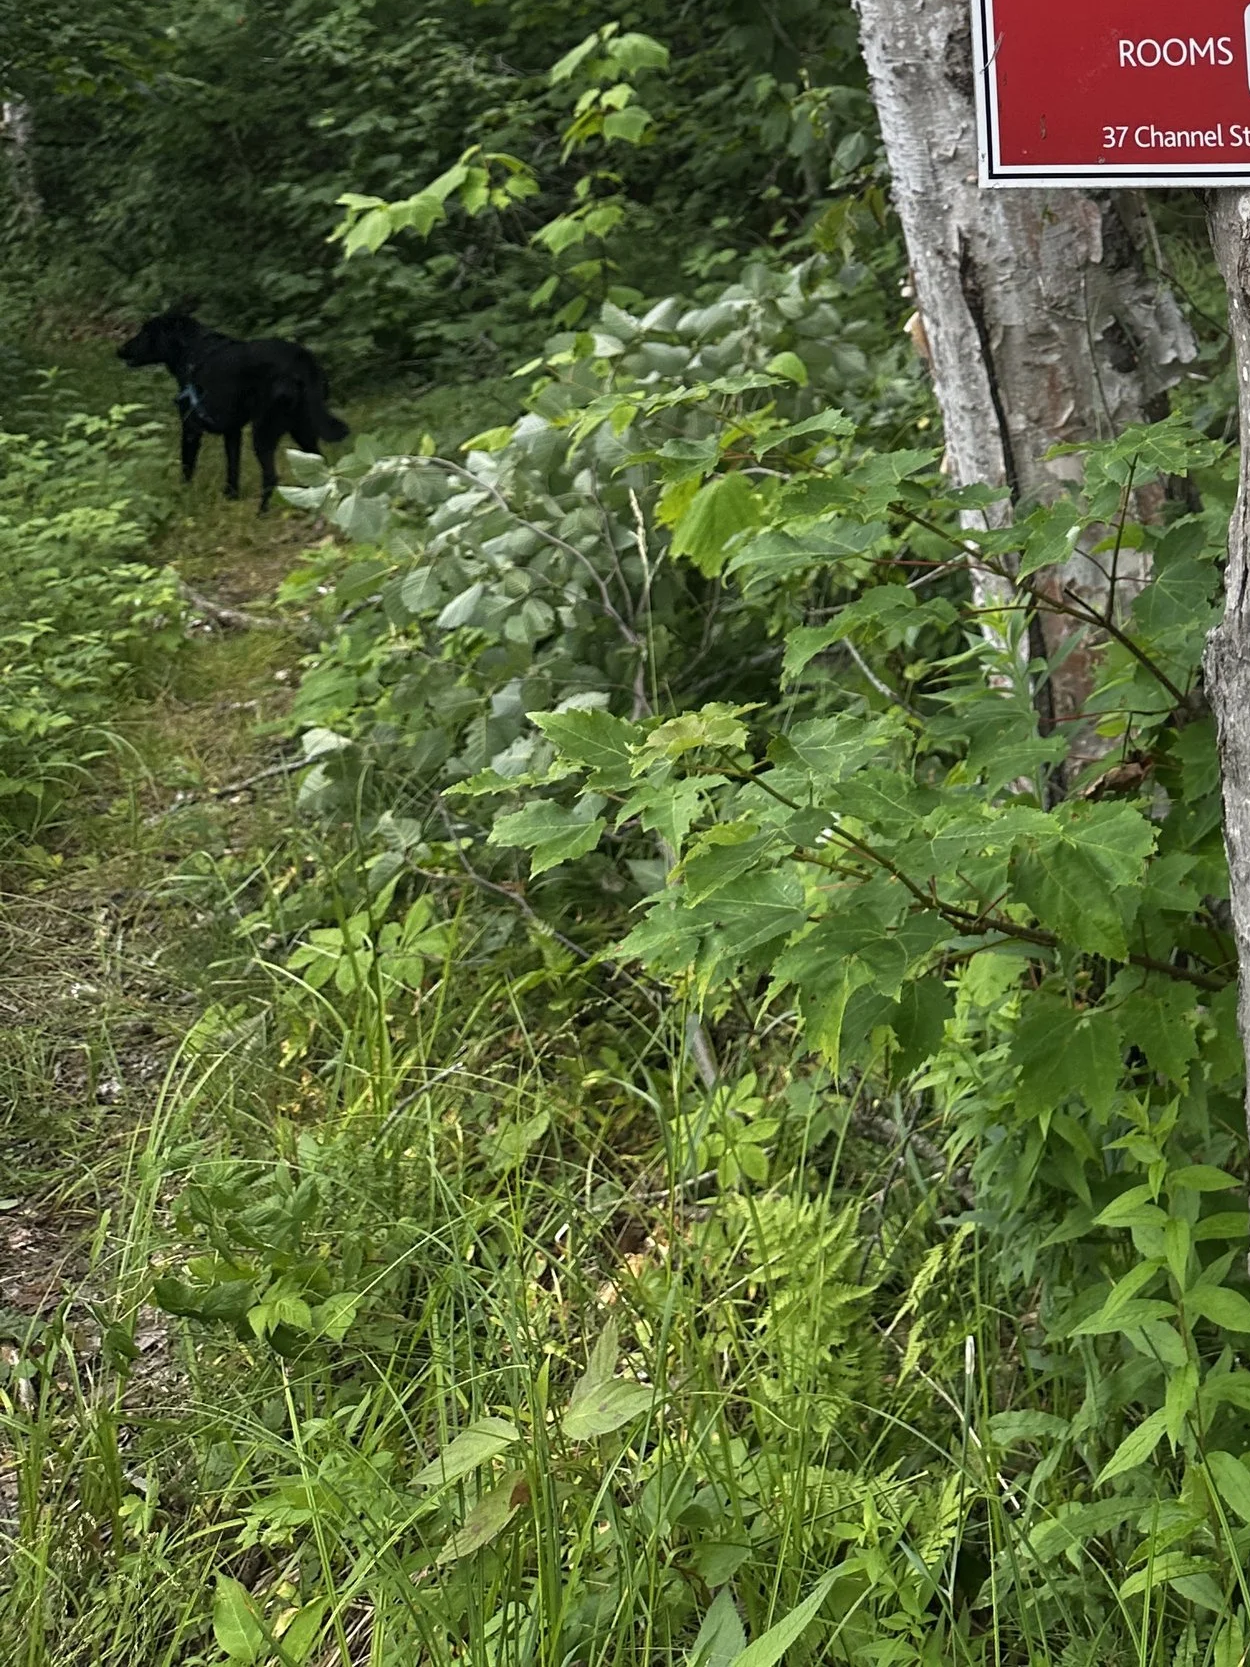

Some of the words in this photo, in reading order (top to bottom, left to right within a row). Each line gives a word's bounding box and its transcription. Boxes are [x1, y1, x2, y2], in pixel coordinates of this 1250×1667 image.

[1118, 37, 1234, 67] ROOMS
[1102, 127, 1128, 148] 37
[1134, 125, 1225, 148] Channel
